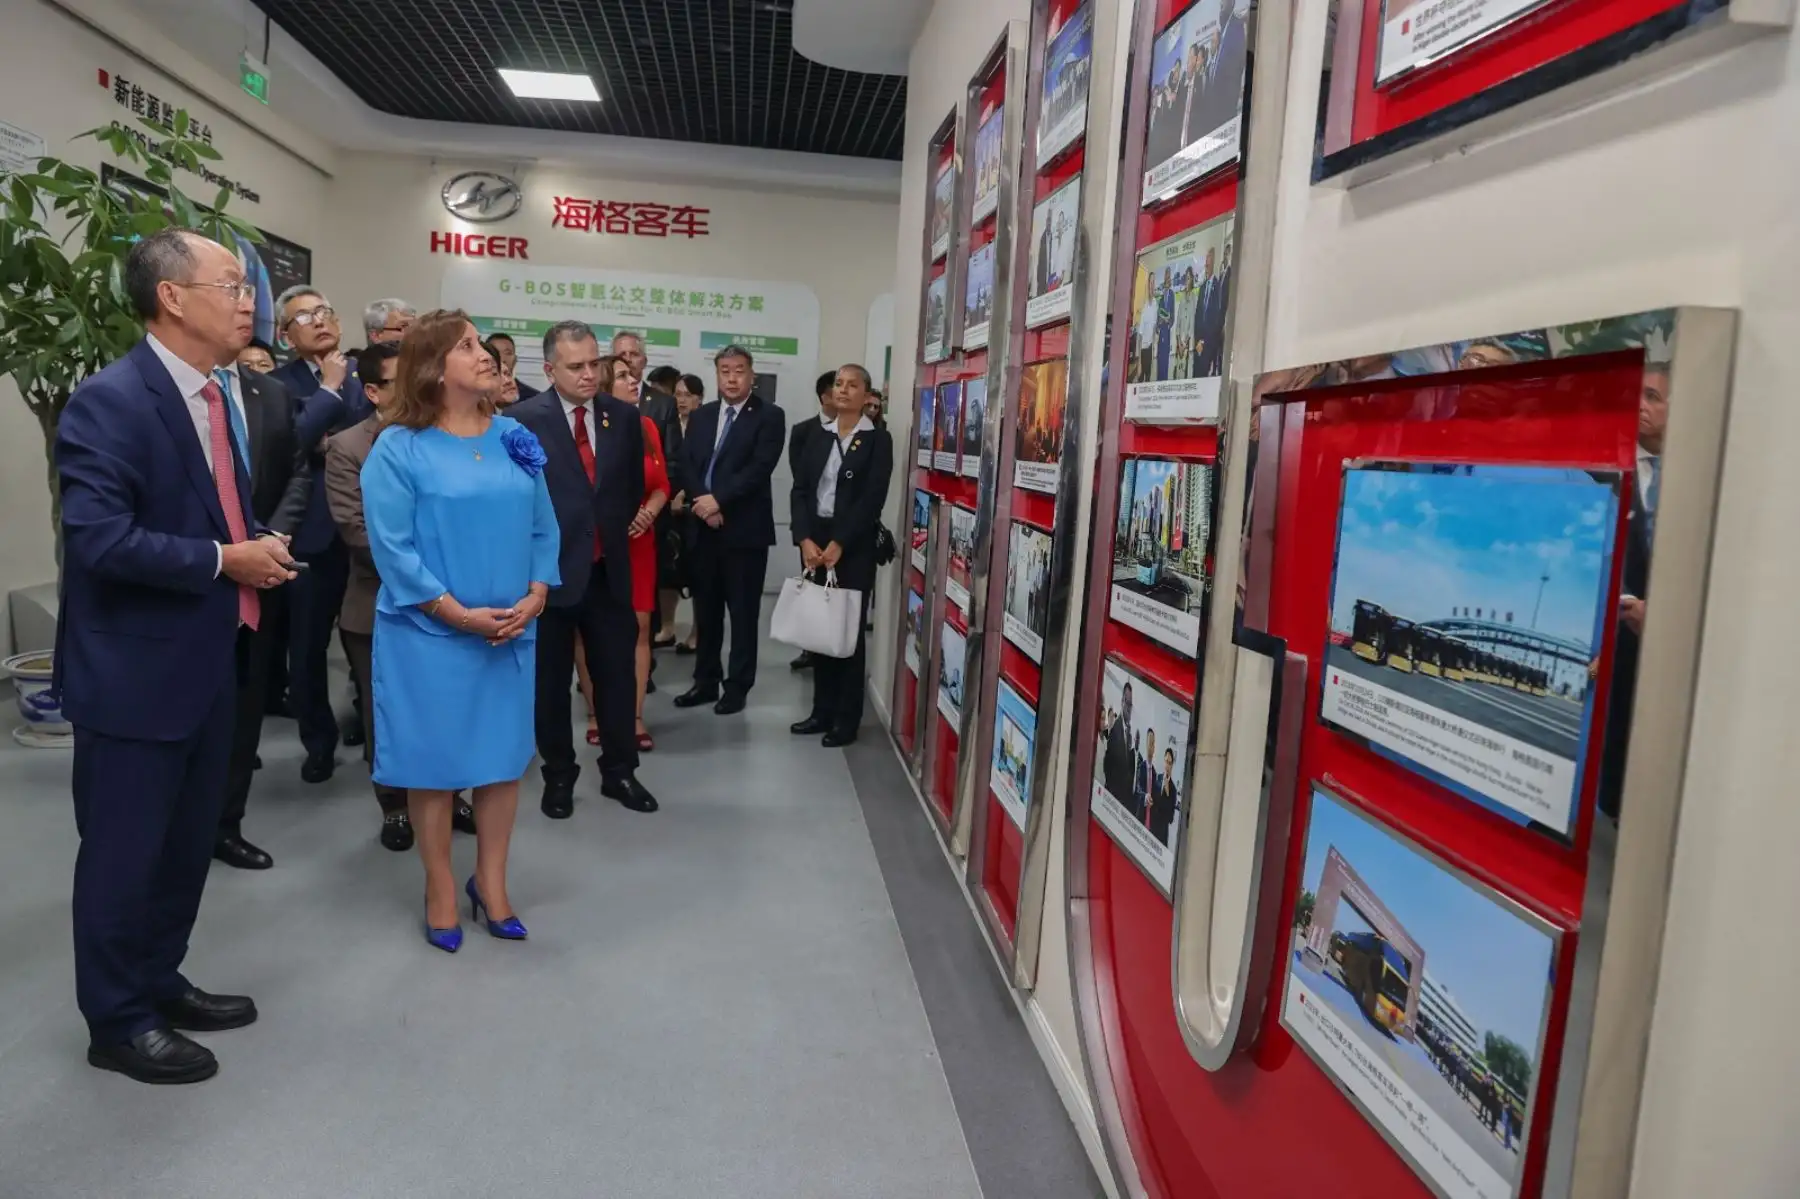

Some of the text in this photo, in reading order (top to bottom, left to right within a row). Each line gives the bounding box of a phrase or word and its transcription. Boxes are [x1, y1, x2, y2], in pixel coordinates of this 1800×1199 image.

[114, 74, 213, 146] 新能源监平台
[552, 196, 710, 238] 海格客车
[430, 231, 528, 259] HIGER
